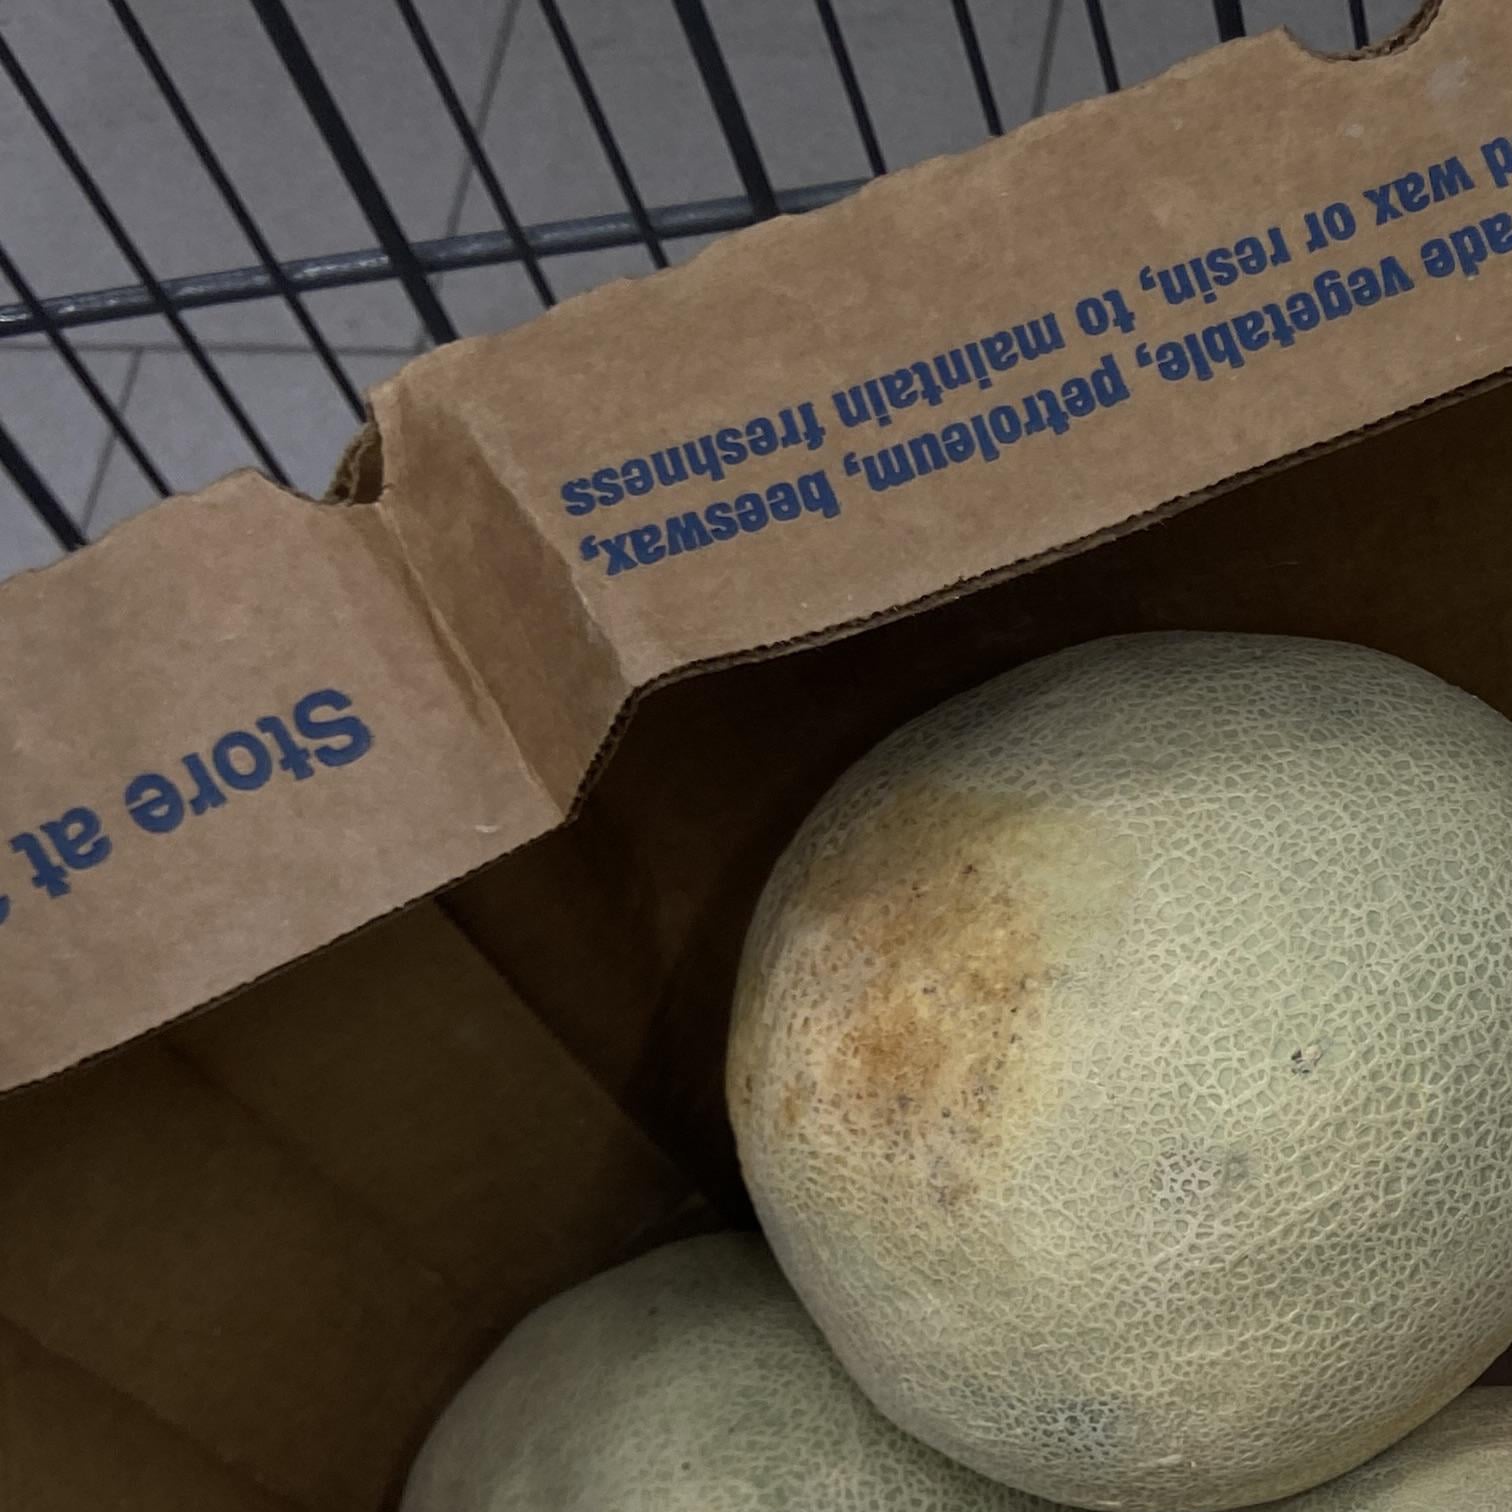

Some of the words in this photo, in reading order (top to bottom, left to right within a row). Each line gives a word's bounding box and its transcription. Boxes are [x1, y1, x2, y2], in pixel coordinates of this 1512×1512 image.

[1306, 202, 1356, 251] or
[1364, 157, 1473, 225] wax
[1076, 289, 1134, 335] to
[1136, 240, 1413, 381] vegetable,
[1139, 227, 1290, 304] resin,
[831, 314, 1064, 427] maintain
[843, 355, 1130, 491] petroleum,
[562, 402, 825, 516] freshness
[580, 471, 840, 576] beeswax,
[124, 689, 371, 833] Store
[11, 808, 111, 897] at
